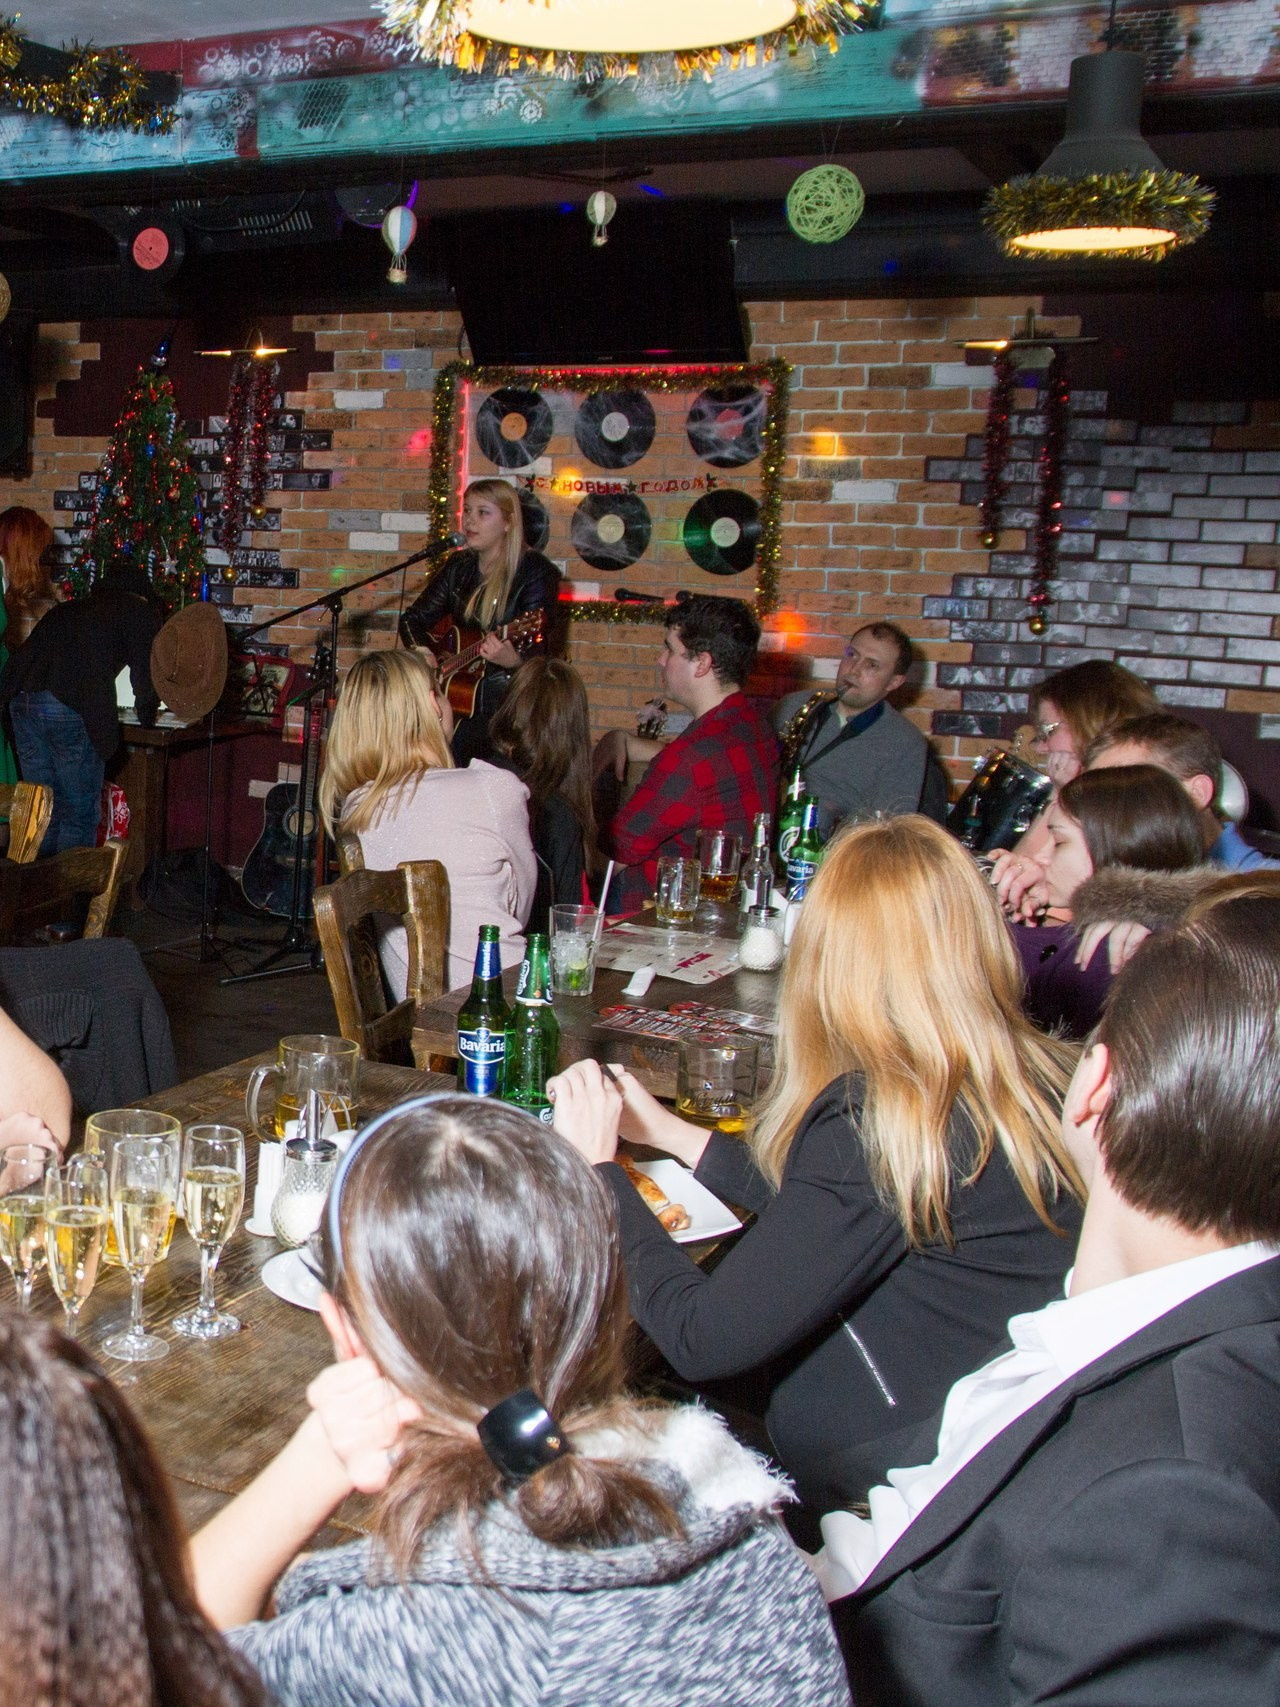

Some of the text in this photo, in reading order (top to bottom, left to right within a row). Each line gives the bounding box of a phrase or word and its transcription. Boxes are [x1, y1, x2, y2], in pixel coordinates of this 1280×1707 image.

[536, 477, 704, 494] С НОВЫМ ГОДОМ
[460, 1036, 506, 1053] Bavaria
